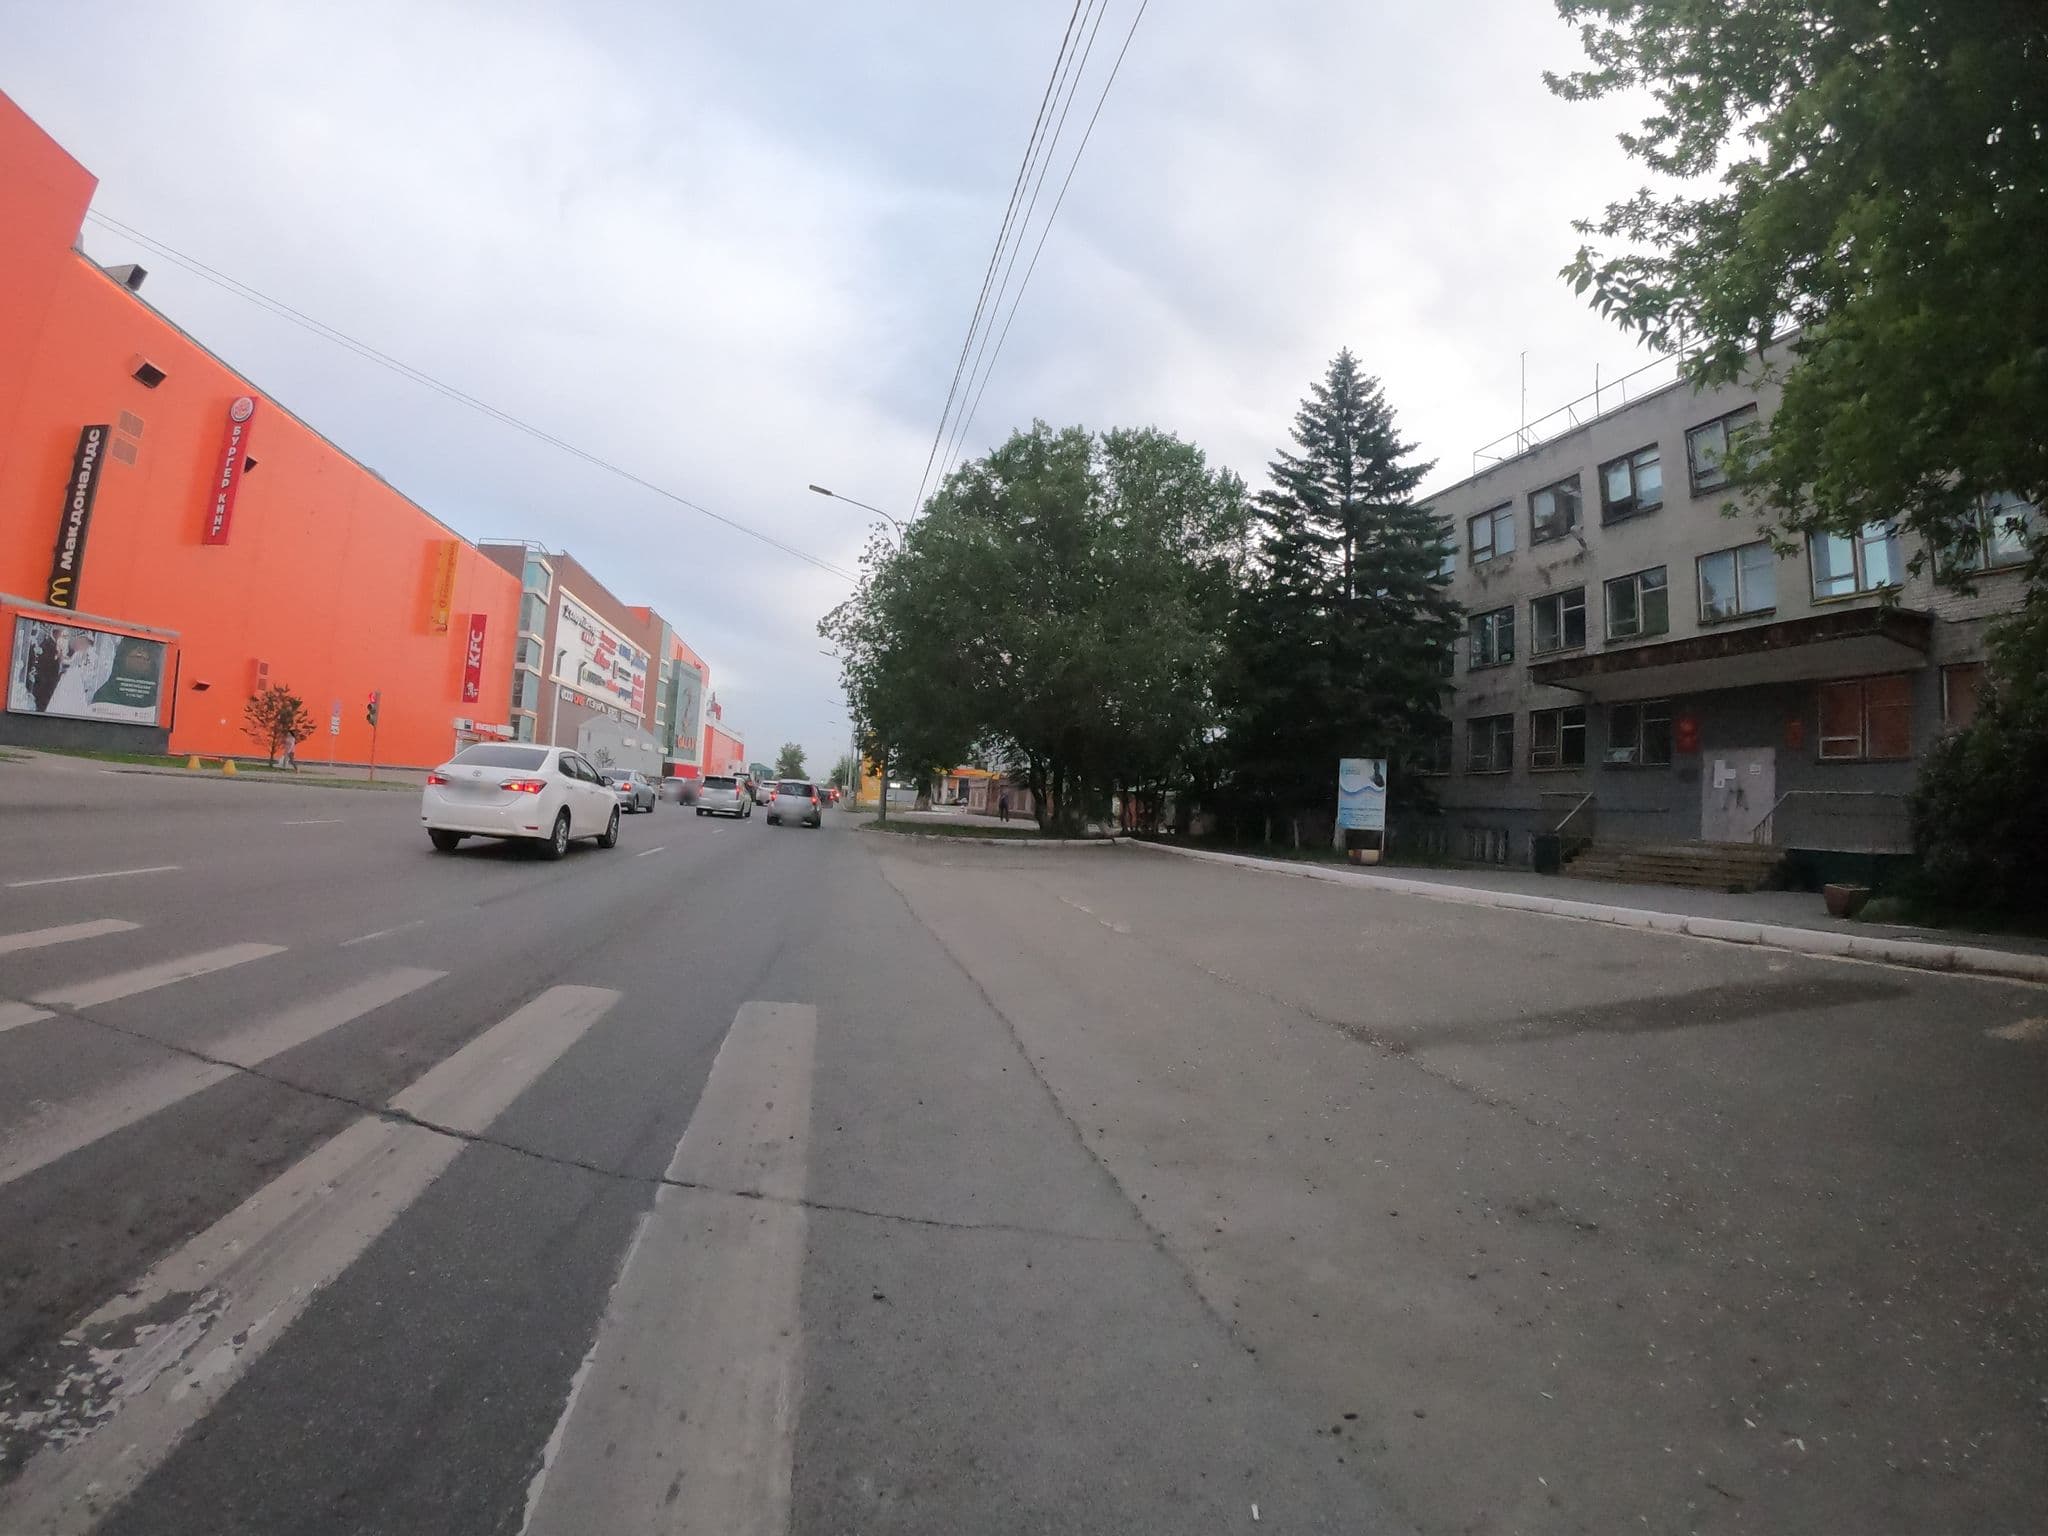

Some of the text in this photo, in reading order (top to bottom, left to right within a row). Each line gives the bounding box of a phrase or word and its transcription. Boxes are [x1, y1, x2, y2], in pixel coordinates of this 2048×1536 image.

[60, 428, 100, 571] Макдоналдс
[211, 425, 242, 537] БУРГЕР КИНГ
[467, 629, 484, 669] KFC
